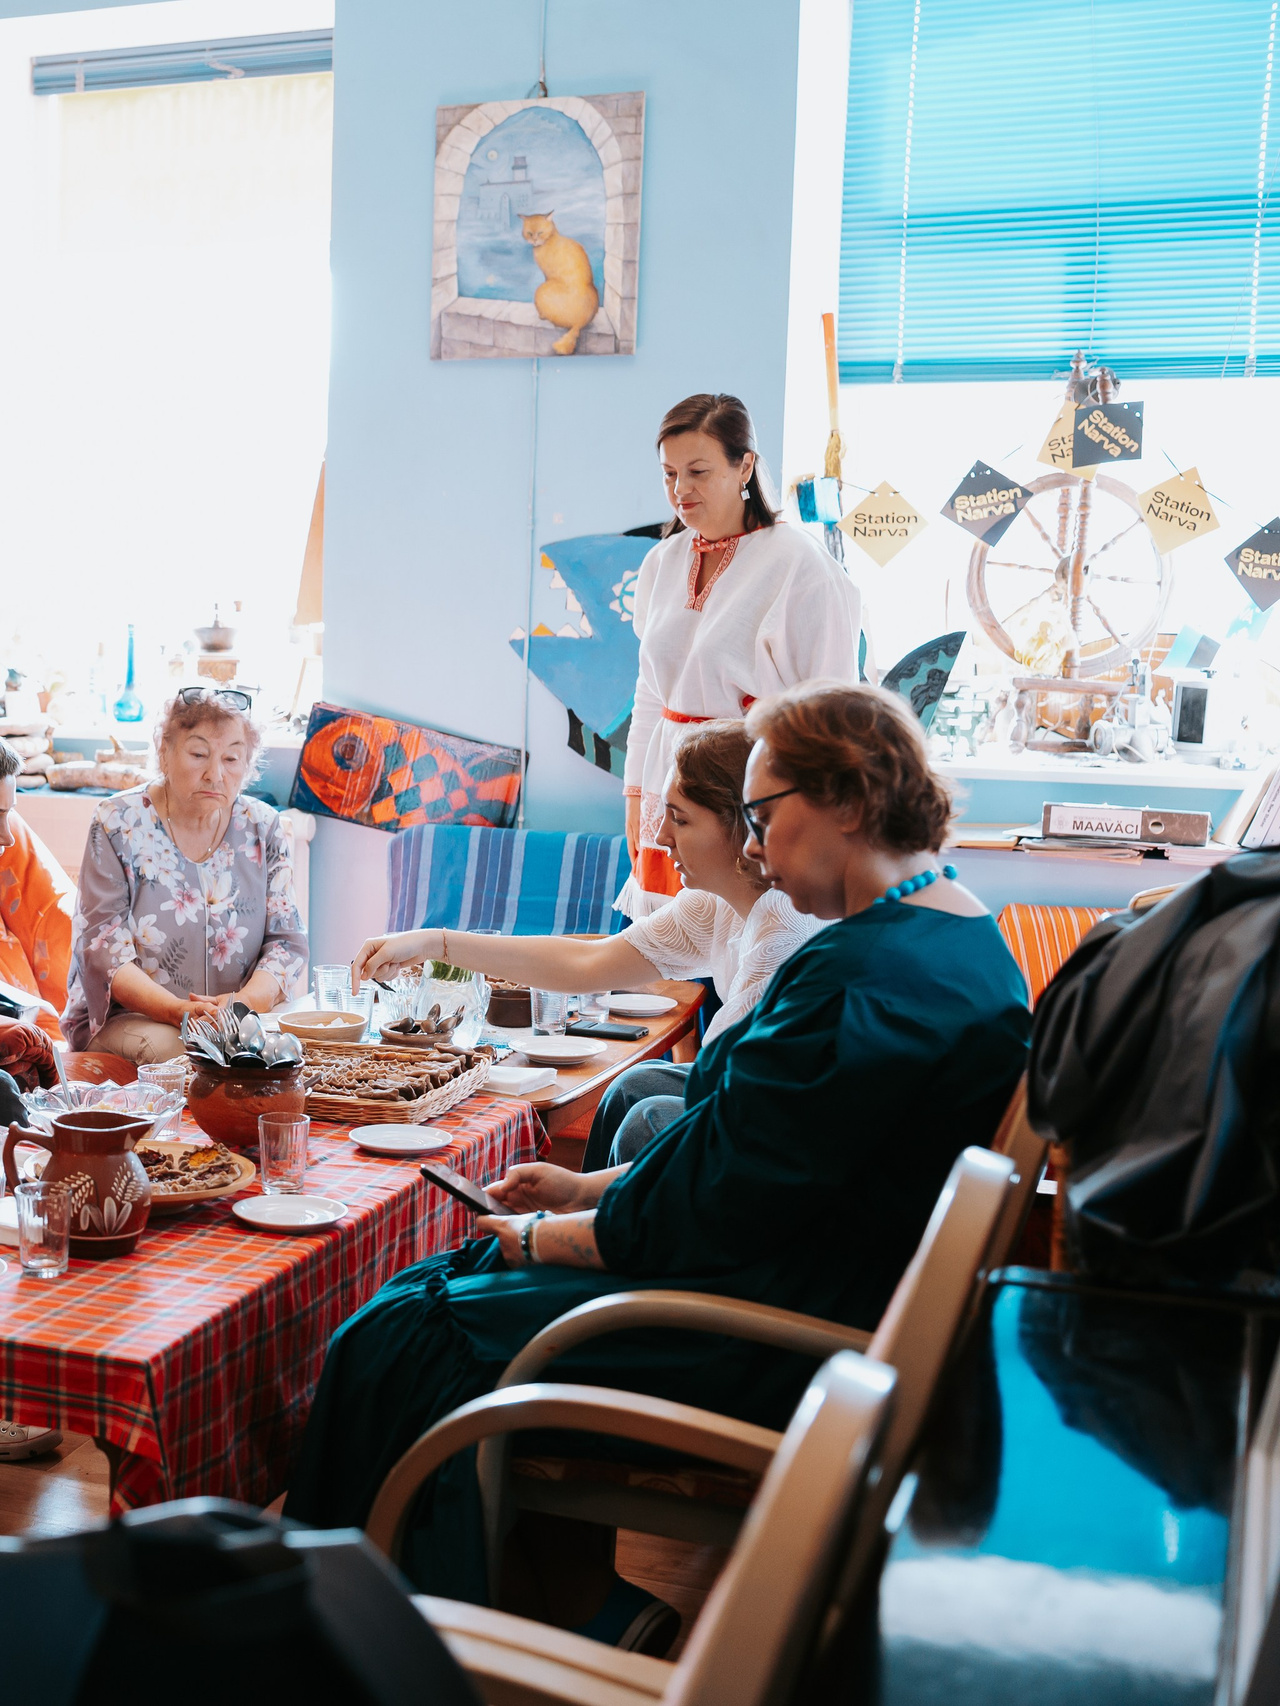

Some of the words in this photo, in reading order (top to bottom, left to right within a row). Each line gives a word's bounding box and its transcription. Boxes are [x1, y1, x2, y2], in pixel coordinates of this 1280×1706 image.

[1077, 418, 1122, 458] Narva
[1088, 409, 1140, 453] Station
[954, 487, 1023, 510] Station
[1152, 490, 1211, 522] Station
[854, 512, 918, 525] Station
[956, 502, 1016, 524] Narva
[1146, 503, 1197, 532] Narva
[853, 526, 909, 538] Narva
